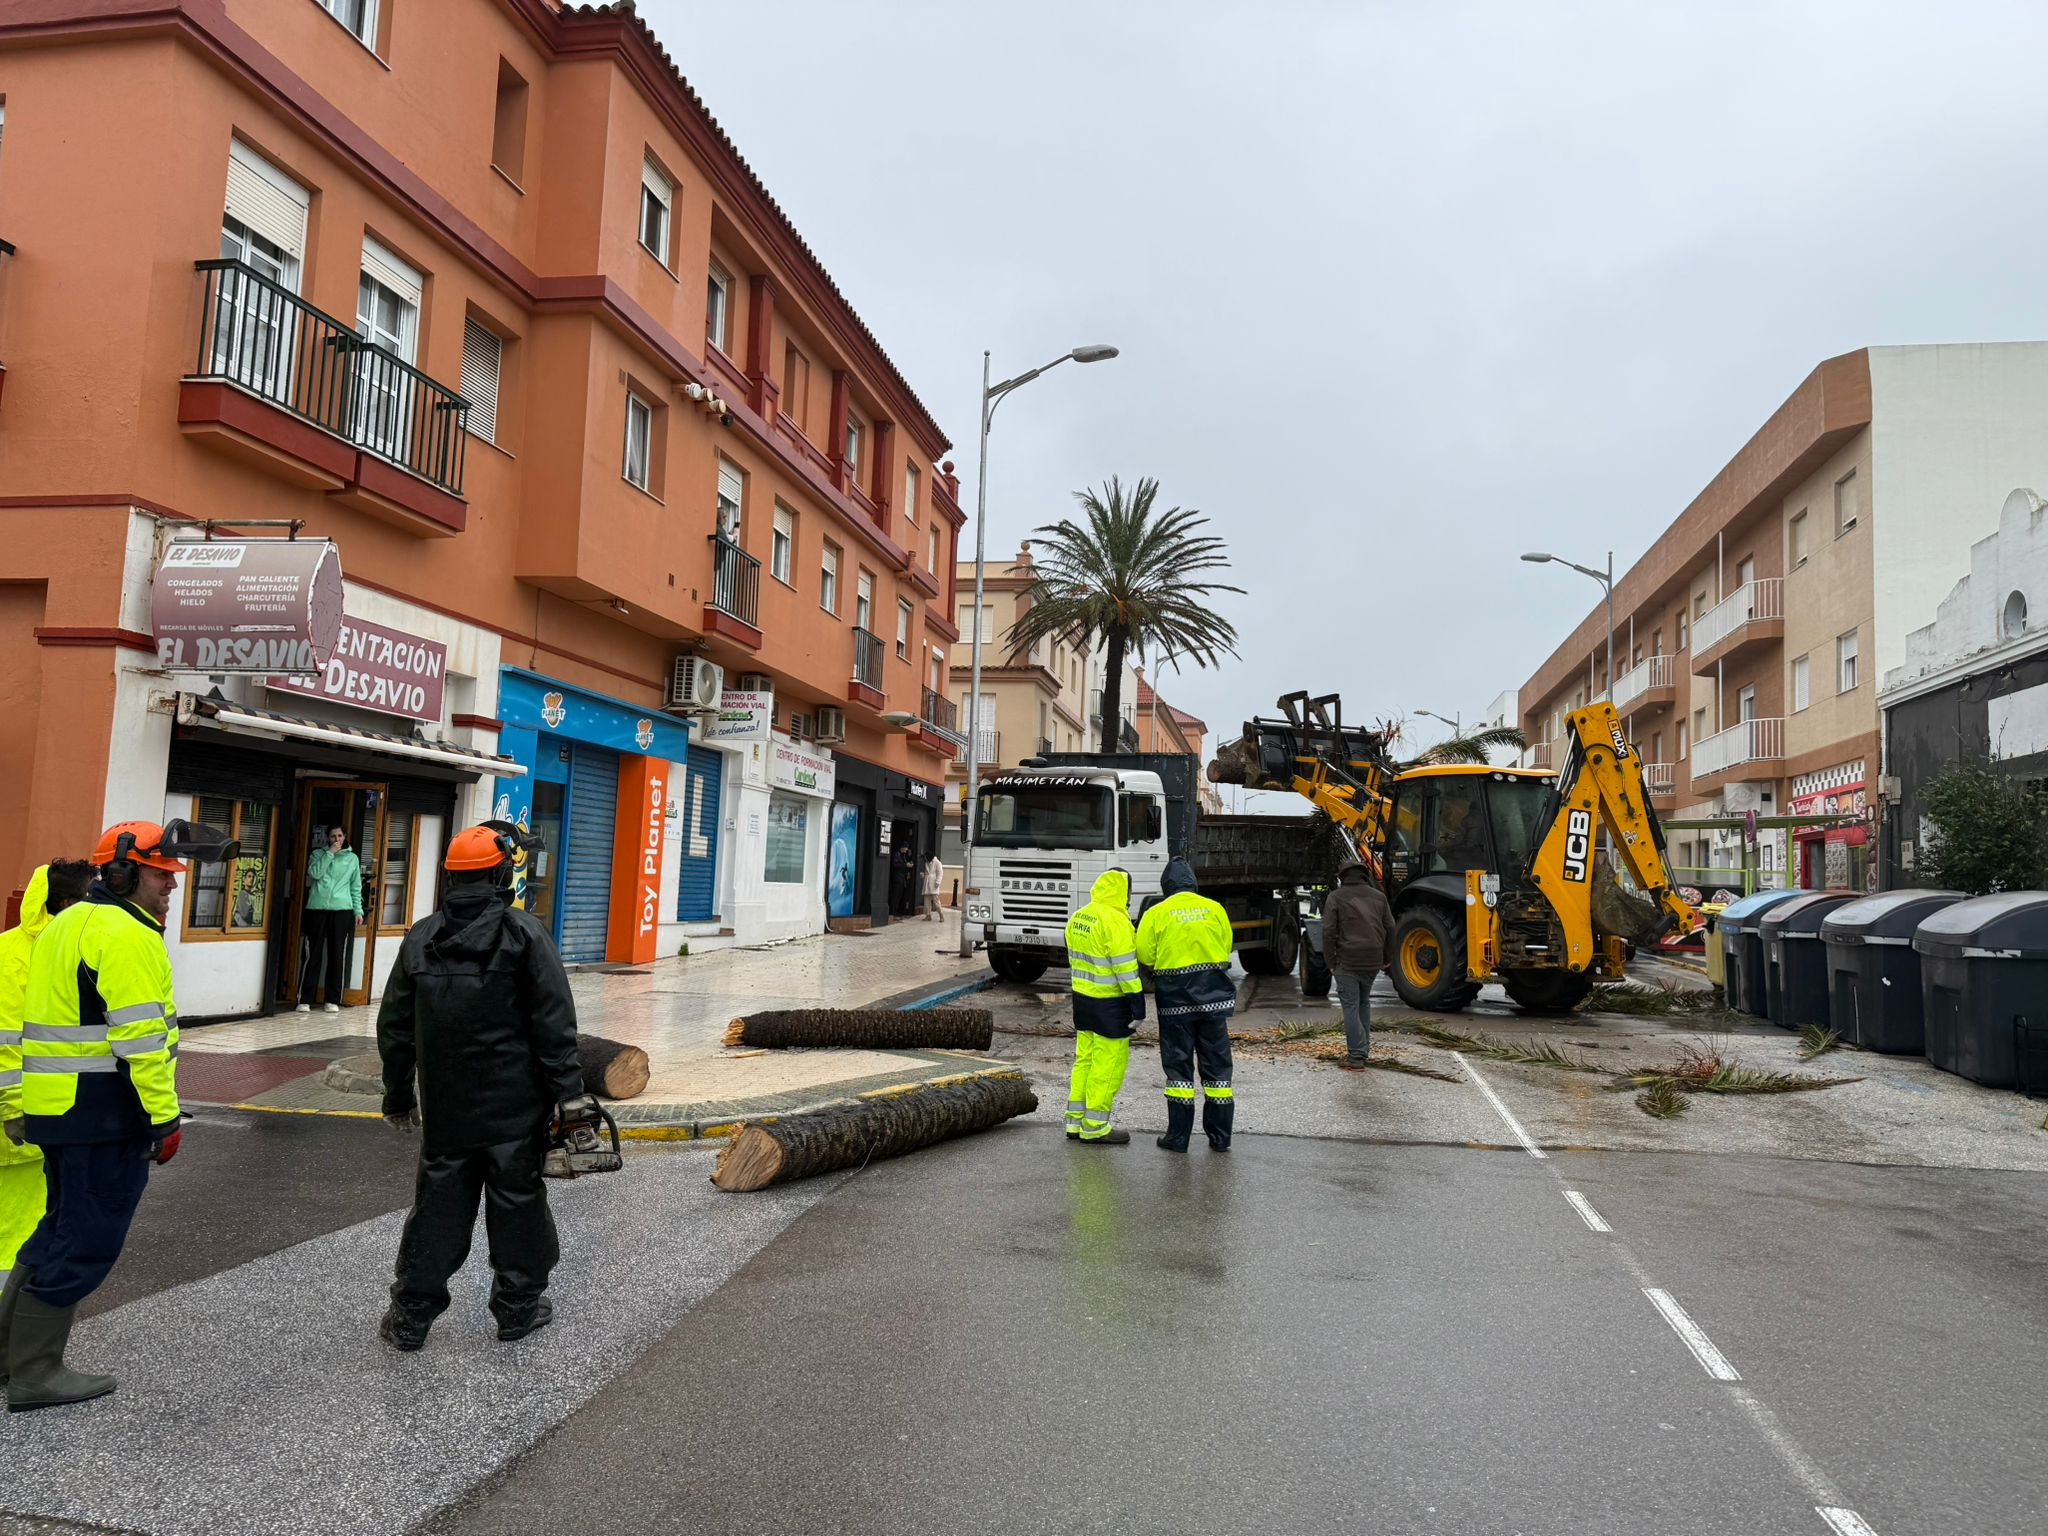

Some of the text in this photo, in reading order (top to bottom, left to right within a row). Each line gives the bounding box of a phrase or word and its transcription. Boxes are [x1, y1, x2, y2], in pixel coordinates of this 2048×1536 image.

[170, 548, 241, 561] EL DESAVIO
[167, 579, 223, 587] CONGELADOS
[258, 575, 300, 583] CALIENTE
[236, 583, 299, 592] ALIMENTACIÓN
[180, 598, 206, 606] HIELO
[236, 593, 296, 601] CHARCUTERÍA
[244, 603, 287, 611] FRUTERÍA
[158, 637, 315, 668] EL DESAVIO
[337, 625, 442, 679] ENTACIÓN
[324, 658, 425, 713] DESAVIO
[721, 693, 746, 701] ENTRO
[542, 708, 565, 719] PLANET
[718, 720, 760, 736] confianza!
[776, 748, 793, 762] CENTRO
[794, 752, 801, 764] DE
[994, 776, 1087, 786] MAGIMETRAN
[1565, 811, 1590, 881] JCB
[640, 776, 662, 938] Toy Planet
[1001, 880, 1069, 892] PEGASO
[1175, 914, 1208, 923] LOCAL
